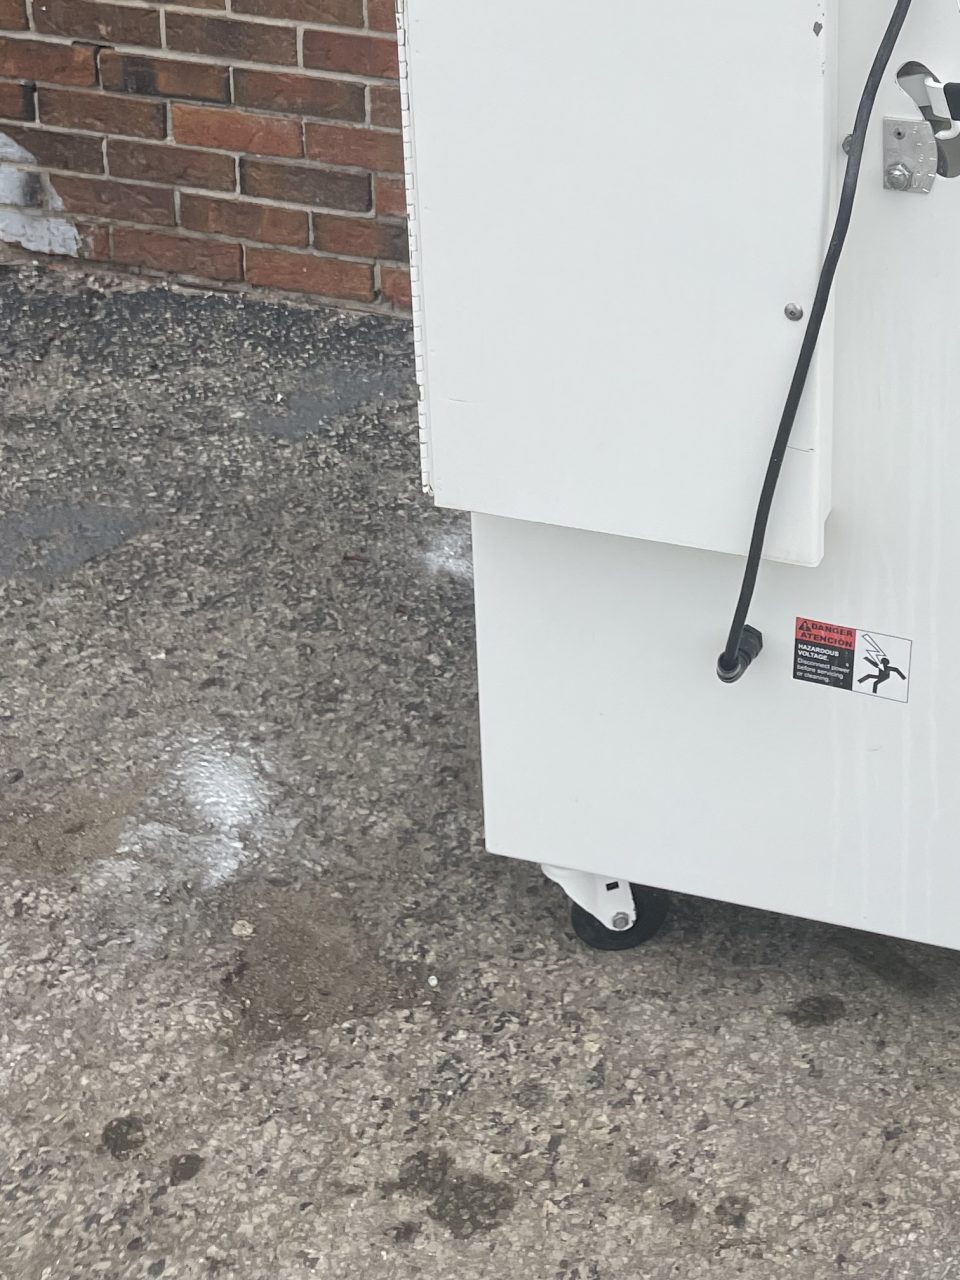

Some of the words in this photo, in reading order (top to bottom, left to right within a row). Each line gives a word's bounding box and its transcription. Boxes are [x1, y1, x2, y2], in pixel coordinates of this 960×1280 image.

[811, 623, 853, 637] DANGER
[800, 631, 853, 648] ATENCIÓN
[797, 650, 830, 662] VOLTAGE.
[798, 643, 840, 657] HAZARDOUS
[797, 657, 831, 670] Disconnect
[831, 665, 850, 674] power
[797, 664, 816, 673] before
[817, 668, 844, 680] servicing
[804, 671, 831, 683] cleaning.
